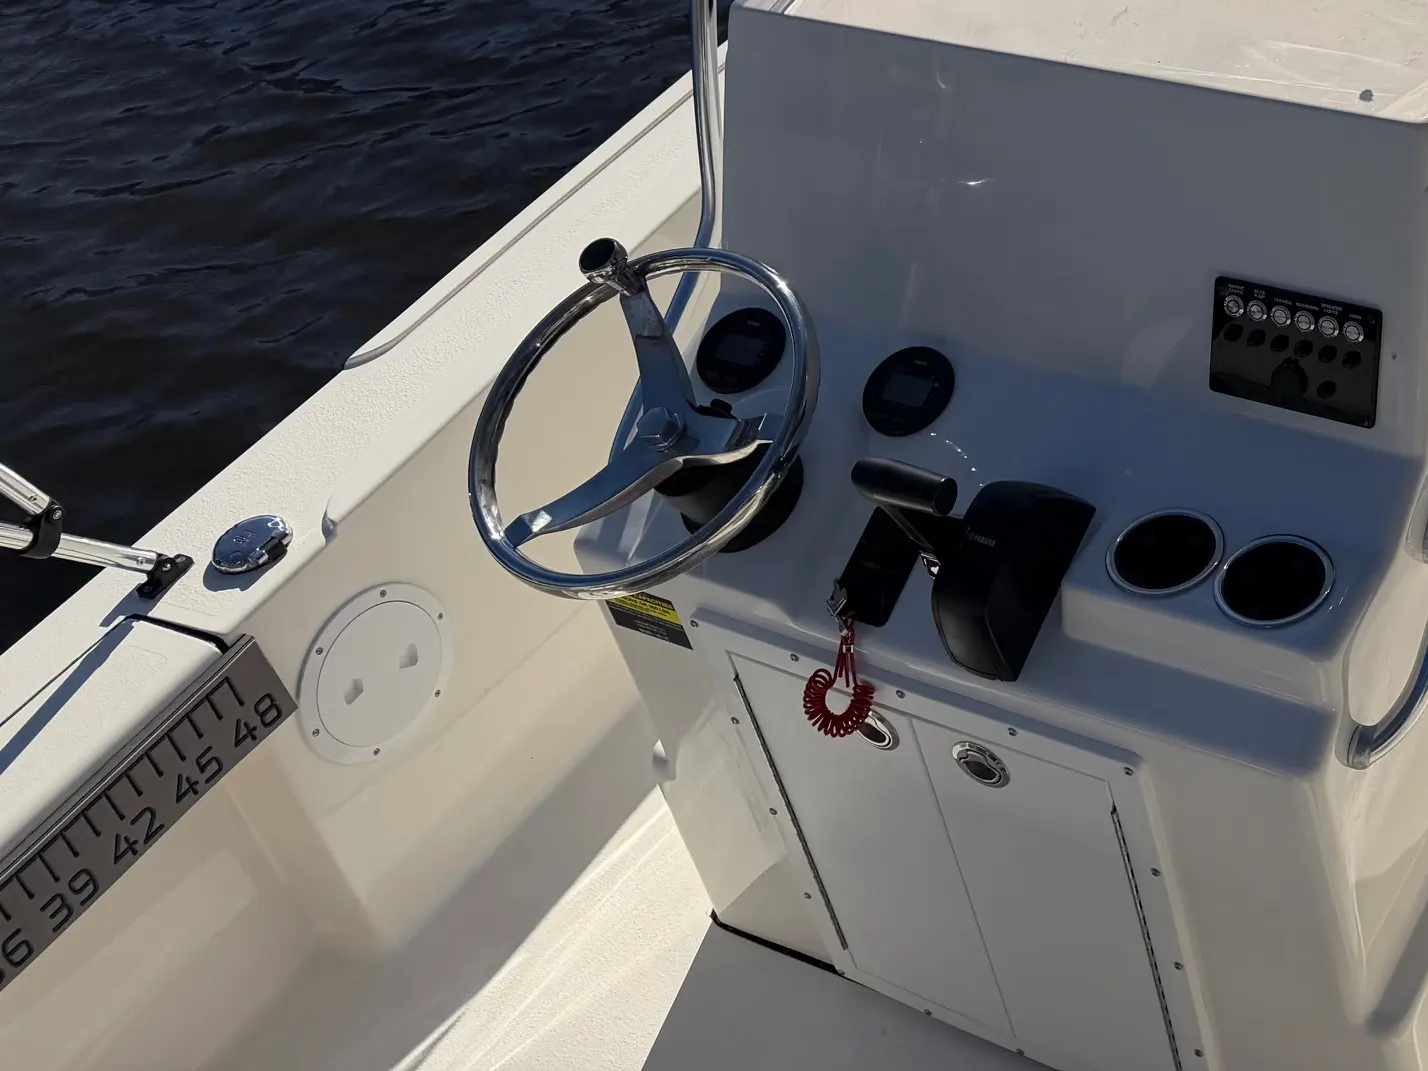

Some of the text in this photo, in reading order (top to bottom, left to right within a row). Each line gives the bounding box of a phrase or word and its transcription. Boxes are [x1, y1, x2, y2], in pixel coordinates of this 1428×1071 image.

[1273, 297, 1293, 306] LIVEWELL
[1321, 303, 1343, 312] SPREADER
[974, 534, 996, 547] YAMAHA
[0, 692, 283, 985] 6 39 42 45 48
